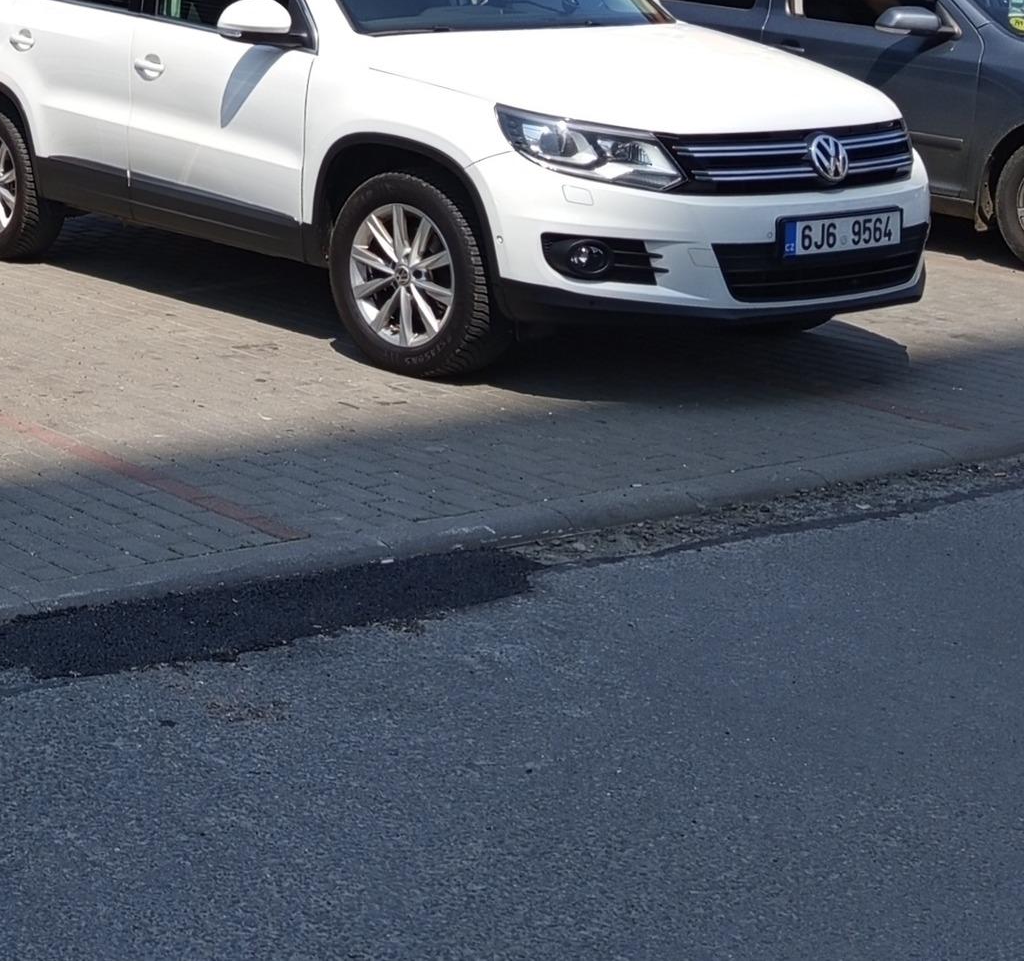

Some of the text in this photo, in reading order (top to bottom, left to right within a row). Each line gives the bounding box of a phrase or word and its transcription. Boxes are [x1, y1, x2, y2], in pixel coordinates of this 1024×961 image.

[801, 215, 893, 251] 6J6 9564
[784, 243, 795, 252] CZ
